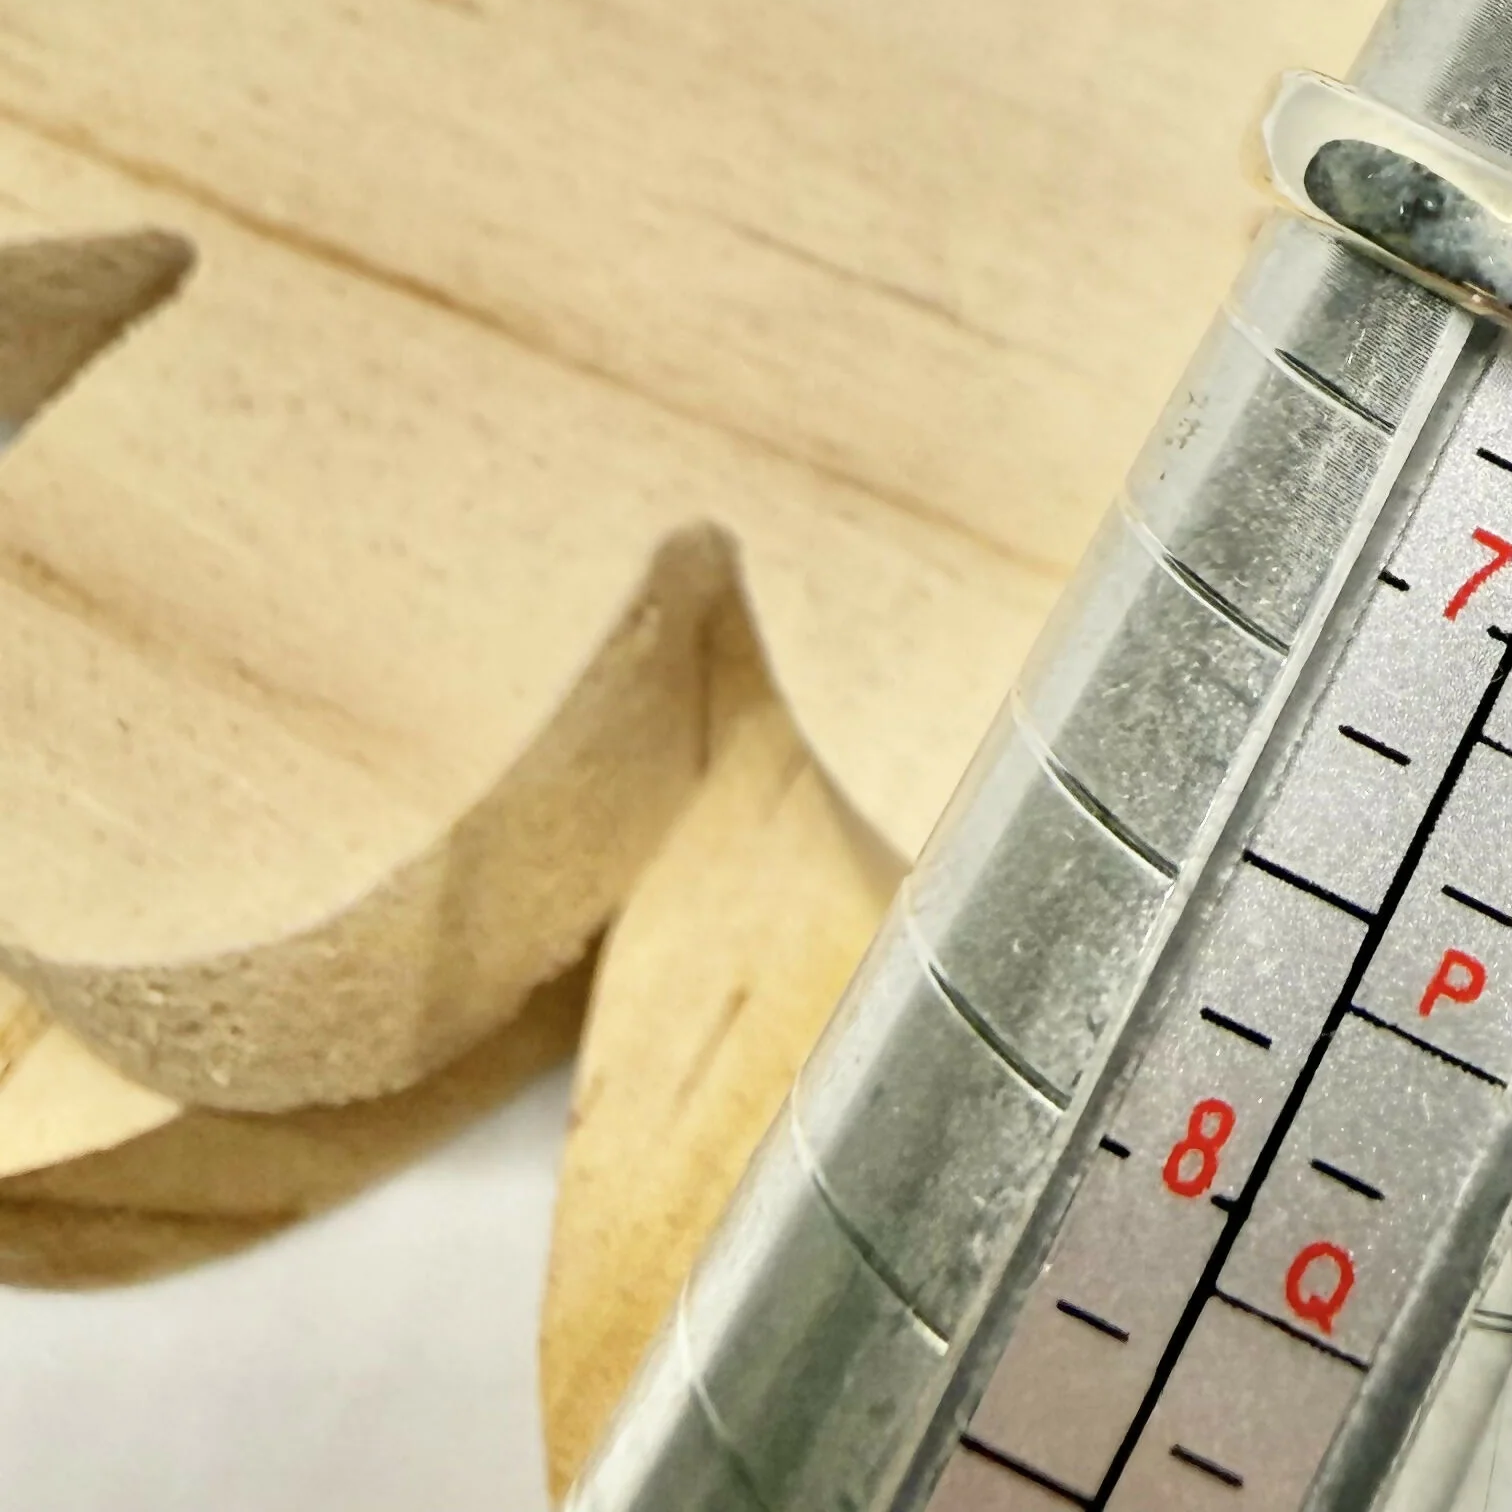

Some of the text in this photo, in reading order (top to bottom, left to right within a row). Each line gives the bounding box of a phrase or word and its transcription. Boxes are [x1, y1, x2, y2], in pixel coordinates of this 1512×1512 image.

[1416, 947, 1489, 1019] P
[1160, 1097, 1237, 1202] 8
[1283, 1239, 1357, 1337] Q
